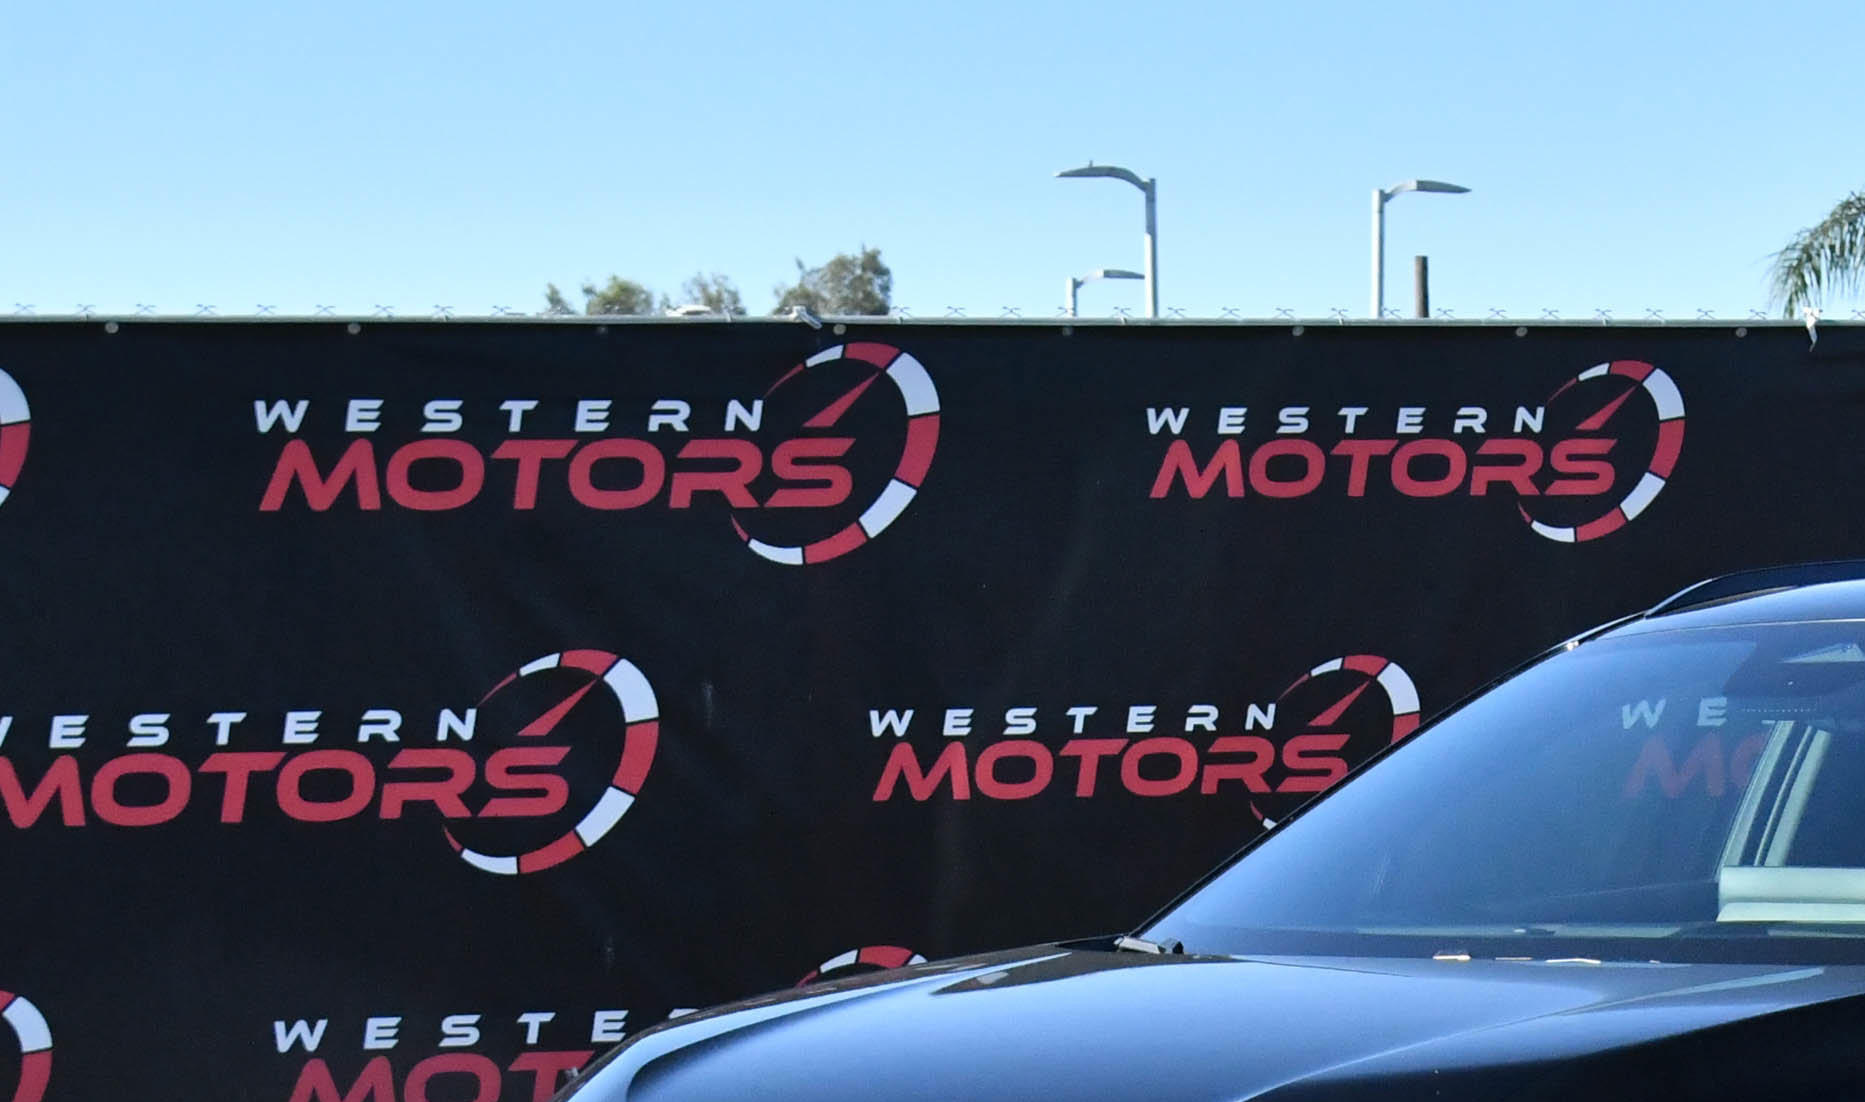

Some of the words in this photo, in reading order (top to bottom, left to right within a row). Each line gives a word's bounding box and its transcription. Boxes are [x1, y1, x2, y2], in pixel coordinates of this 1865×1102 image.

[255, 399, 763, 433] WESTERN
[1147, 406, 1545, 435] WESTERN
[260, 437, 854, 511] MOTORS
[1150, 438, 1616, 498] MOTORS
[869, 703, 1276, 737] WESTERN
[0, 746, 570, 828] MOTORS
[872, 733, 1351, 801] MOTORS
